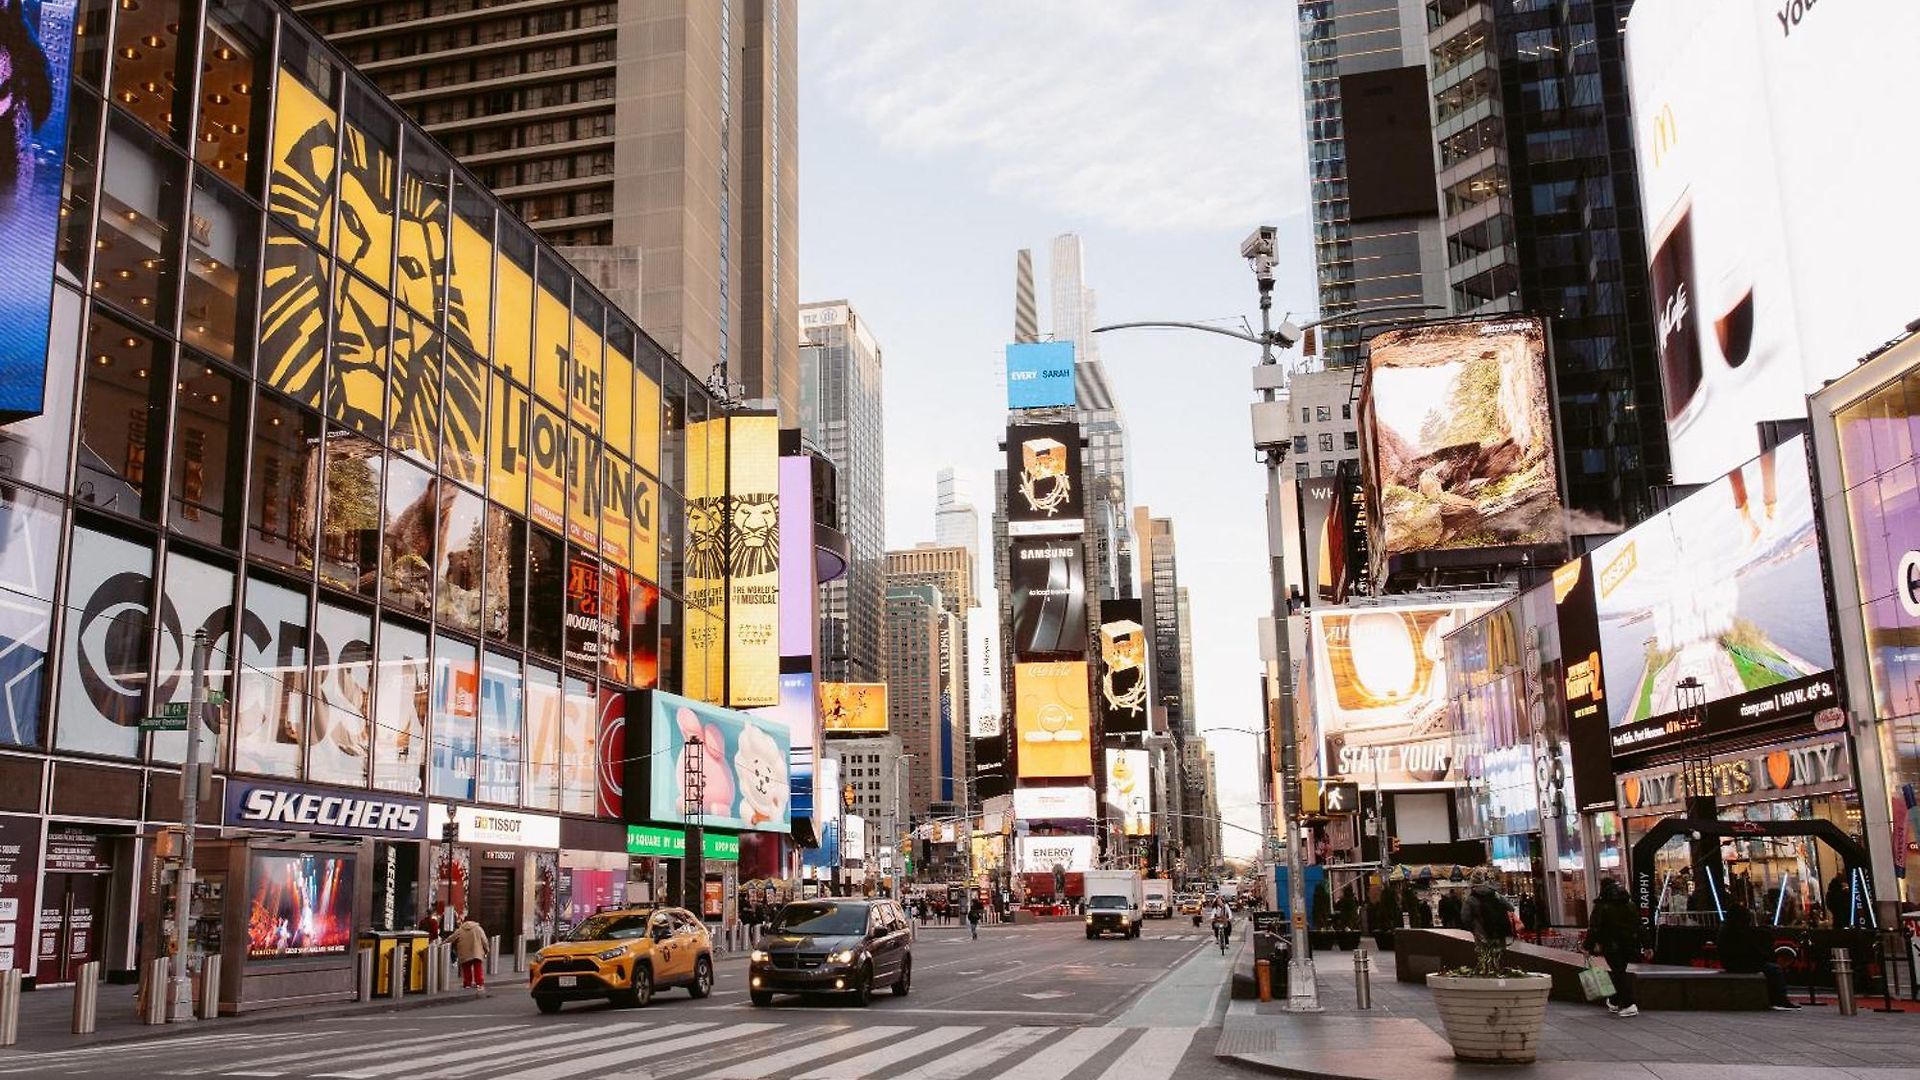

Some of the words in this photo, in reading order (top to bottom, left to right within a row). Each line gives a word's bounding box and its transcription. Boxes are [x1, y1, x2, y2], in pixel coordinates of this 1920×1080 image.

[555, 344, 600, 408] THE
[1012, 371, 1038, 381] EVERY
[1042, 369, 1070, 378] SARAH
[501, 364, 578, 488] LION
[582, 422, 650, 531] KING
[1020, 548, 1073, 560] SAMSUNG
[741, 595, 777, 605] MUSICAL
[1780, 691, 1795, 707] 160
[1795, 688, 1807, 703] W.
[1821, 682, 1833, 697] St.
[1338, 743, 1391, 774] START
[1400, 743, 1447, 772] YOUR
[243, 789, 421, 833] SKECHERS
[489, 817, 522, 832] TISSOT
[635, 833, 661, 847] SQUARE
[663, 837, 671, 848] BY
[494, 851, 516, 860] TISSOT
[1033, 848, 1074, 858] ENERGY
[385, 845, 397, 931] SKECHERS
